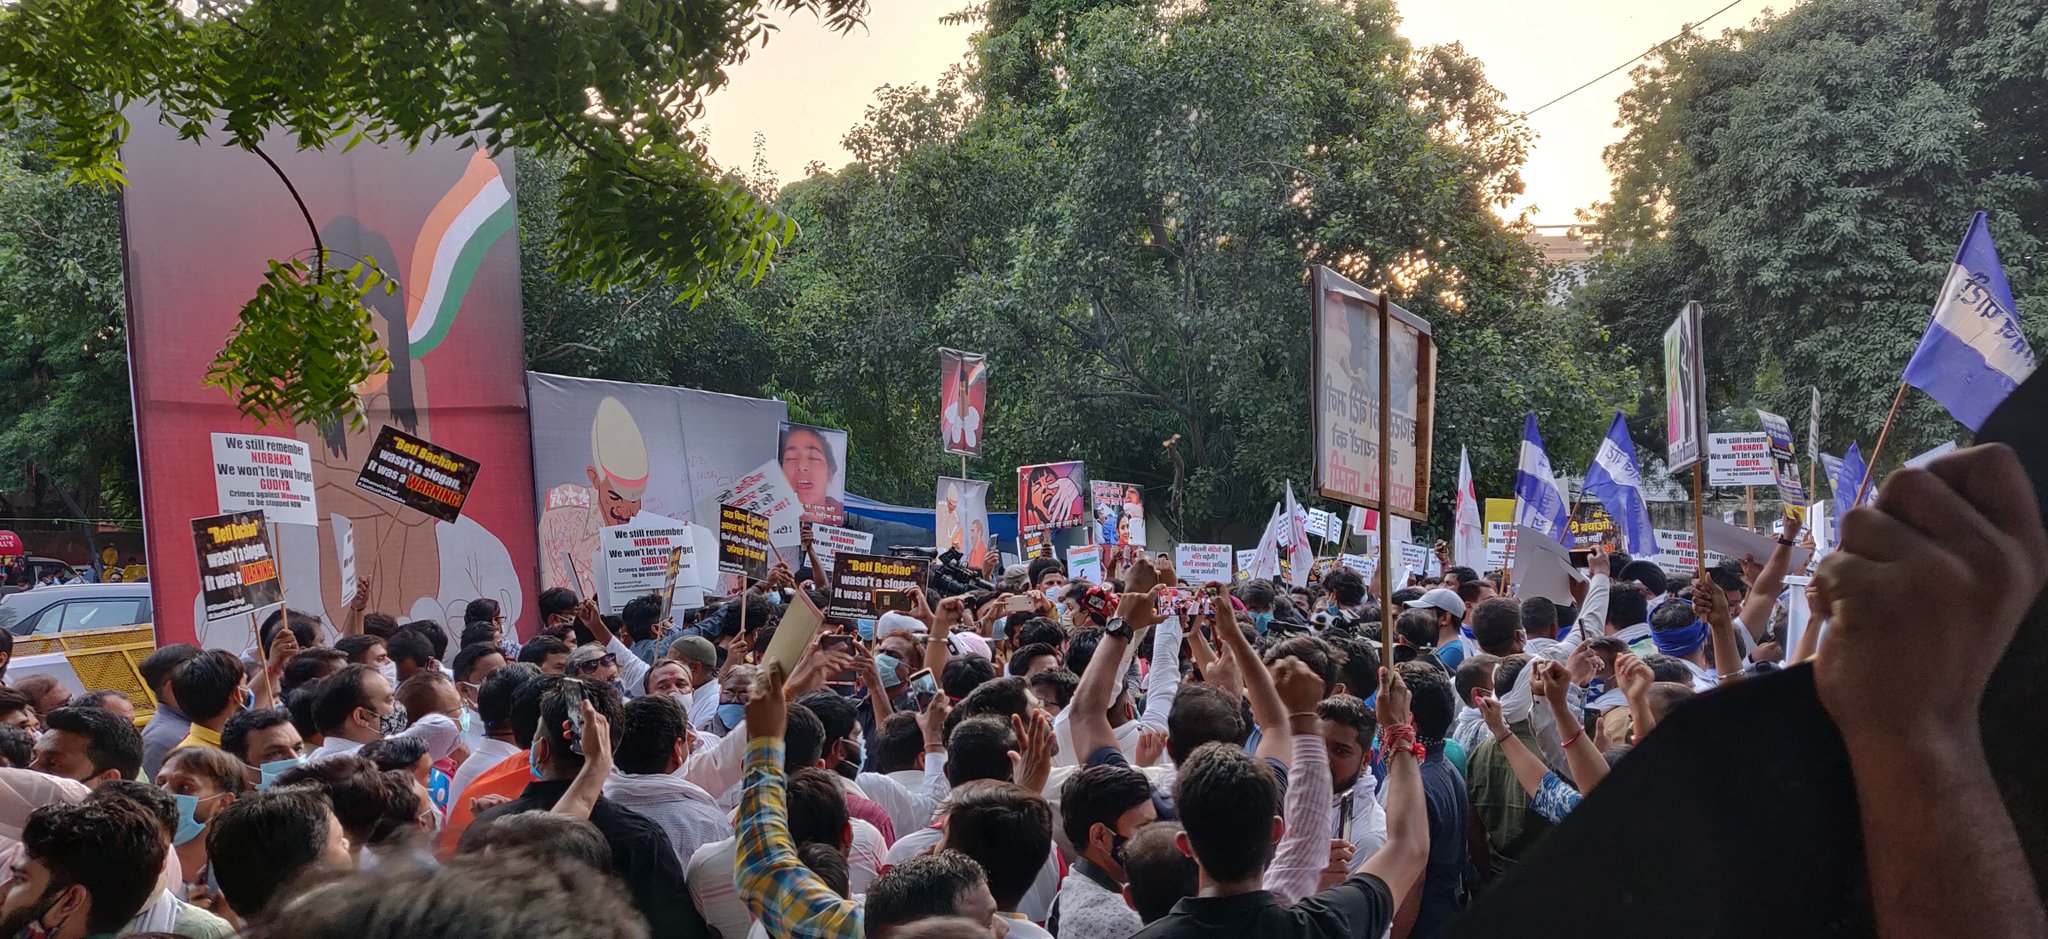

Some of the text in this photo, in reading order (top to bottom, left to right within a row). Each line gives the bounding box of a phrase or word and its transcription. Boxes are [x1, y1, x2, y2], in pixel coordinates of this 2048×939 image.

[225, 437, 304, 456] We still remember
[1732, 444, 1764, 452] NIRBHAYA
[251, 452, 292, 466] NIRBHAYA
[394, 436, 464, 472] "Beti Bachao"
[1722, 452, 1740, 460] won't
[218, 464, 235, 475] We
[237, 465, 264, 476] won't
[266, 466, 278, 478] let
[280, 469, 293, 480] you
[380, 450, 460, 490] wasn't a slogan.
[260, 479, 291, 491] GUDIYA
[368, 460, 464, 508] It was a WARNING!
[230, 490, 254, 498] Crimes
[266, 500, 290, 508] stopped
[208, 524, 234, 544] "Beti
[615, 528, 684, 538] We still remember
[840, 530, 867, 540] remember
[1662, 532, 1686, 540] We still
[634, 537, 670, 547] NIRBHAYA
[820, 540, 835, 548] won't
[206, 547, 239, 568] wasn't
[238, 548, 244, 562] a
[609, 546, 671, 558] We won't let you
[1685, 548, 1694, 556] let
[642, 556, 668, 566] GUDIYA
[848, 560, 916, 576] "Beti Bachao"
[204, 574, 216, 592] It
[216, 572, 236, 589] was
[236, 571, 242, 584] a
[841, 575, 874, 587] wasn't
[876, 579, 882, 588] a
[834, 588, 871, 600] It was a
